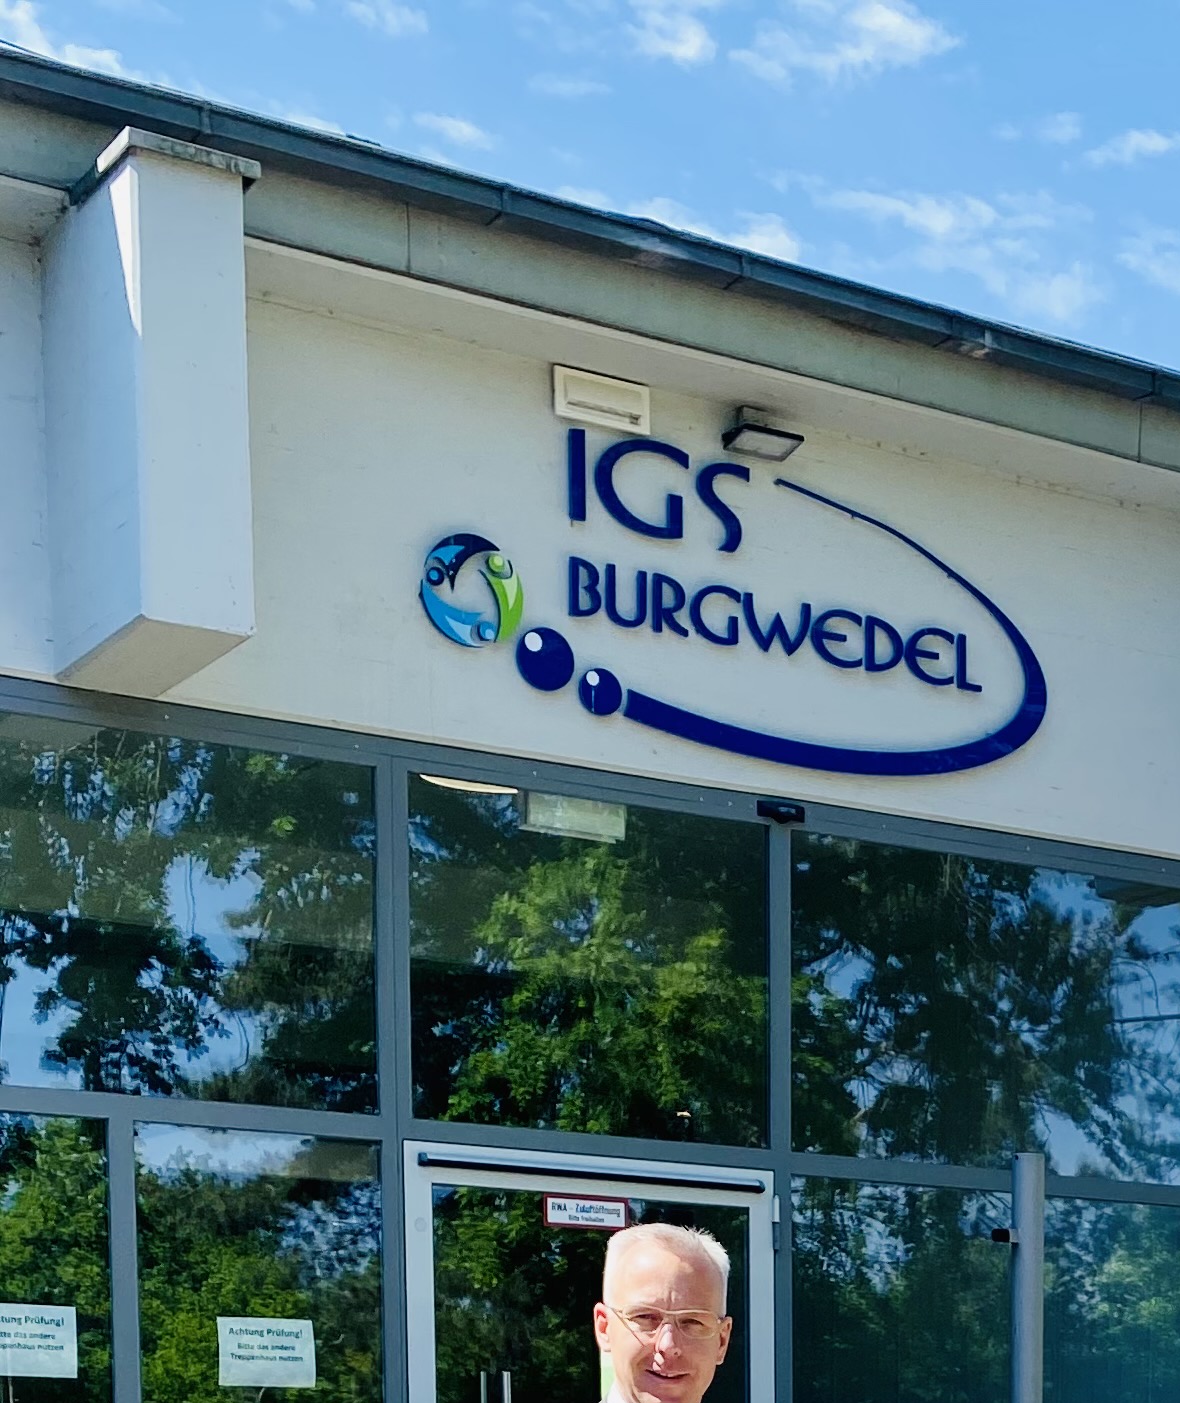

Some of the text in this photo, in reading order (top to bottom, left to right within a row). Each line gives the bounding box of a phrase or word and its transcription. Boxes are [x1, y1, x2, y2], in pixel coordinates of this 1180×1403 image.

[568, 428, 750, 552] IGS
[568, 556, 982, 692] BURGWEDEL
[551, 1201, 567, 1212] RWA
[0, 1315, 65, 1327] tung Prüfung!
[228, 1327, 303, 1339] Achtung Prüfung!
[237, 1342, 296, 1352] Bitte das andere
